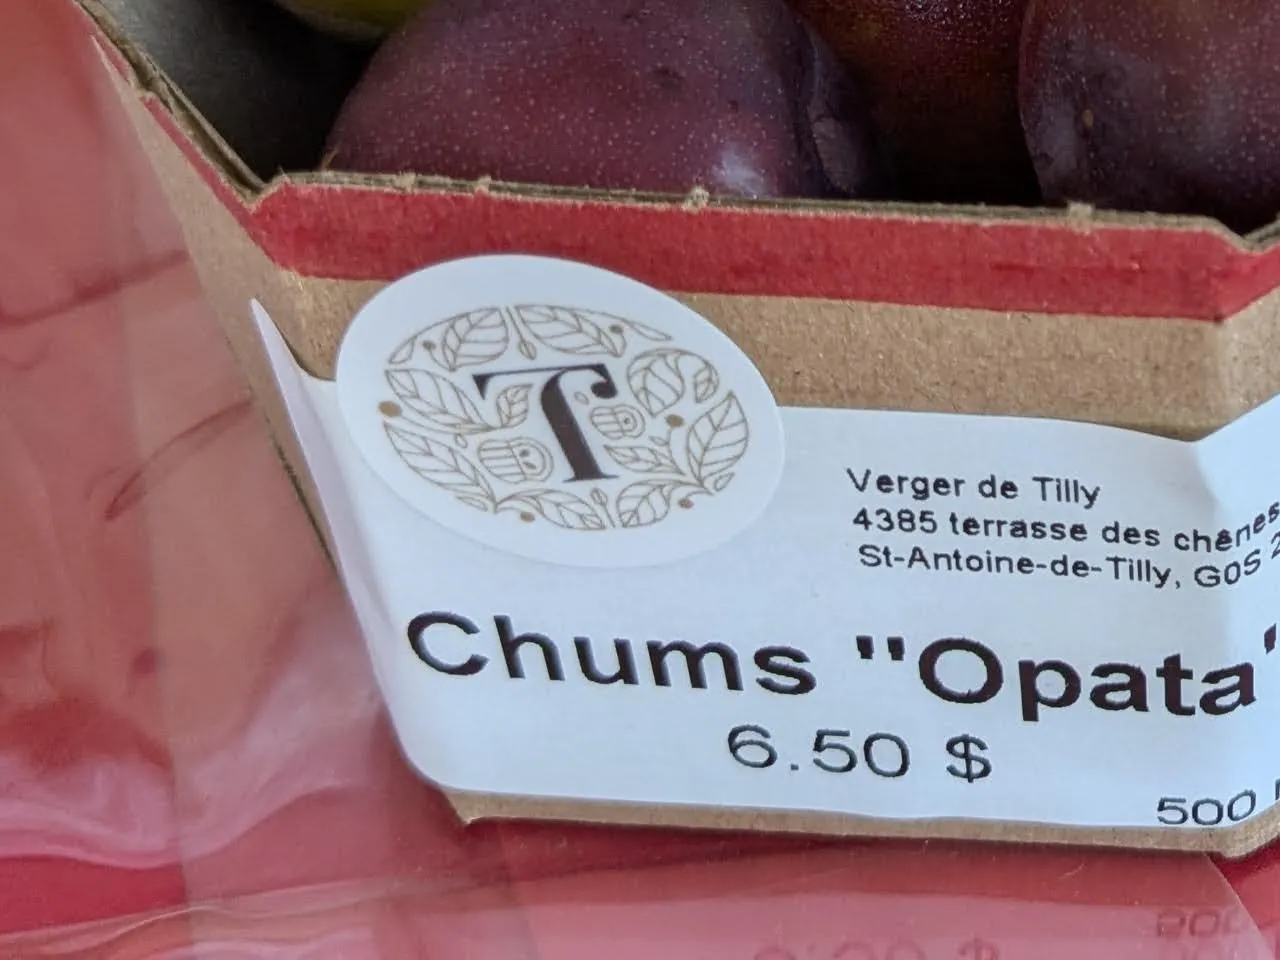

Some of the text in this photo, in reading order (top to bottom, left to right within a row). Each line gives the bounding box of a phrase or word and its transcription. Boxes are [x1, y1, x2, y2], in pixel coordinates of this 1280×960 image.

[472, 362, 620, 483] T
[847, 467, 1101, 510] Verger de Tilly
[852, 508, 938, 534] 4385
[948, 510, 1089, 541] terrasse
[1101, 520, 1161, 547] des
[858, 544, 1182, 589] St-Antoine-de-Tilly,
[406, 611, 817, 696] Chums
[727, 724, 992, 783] 6.50 $
[1156, 789, 1258, 826] 500
